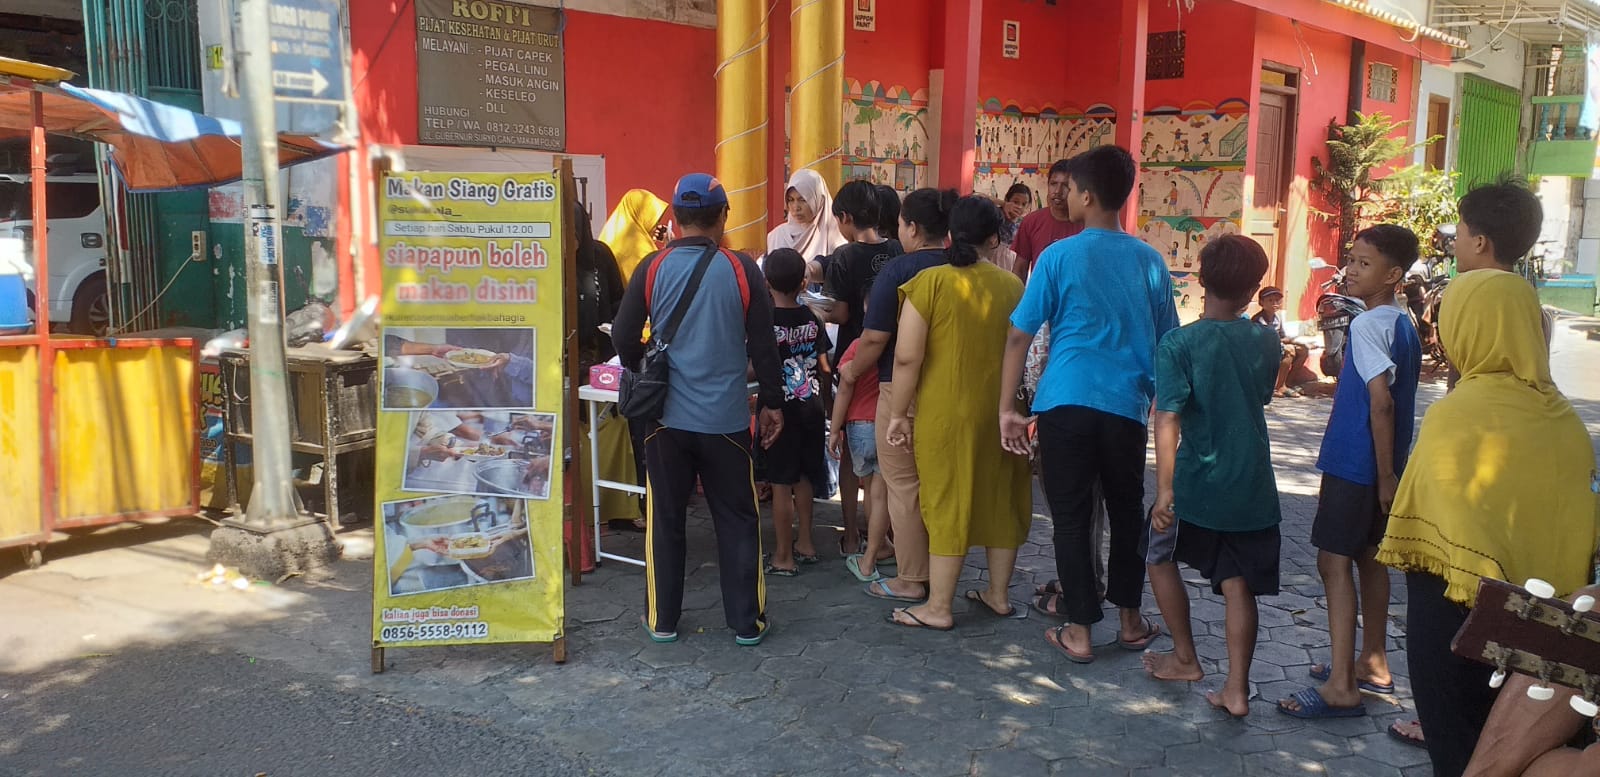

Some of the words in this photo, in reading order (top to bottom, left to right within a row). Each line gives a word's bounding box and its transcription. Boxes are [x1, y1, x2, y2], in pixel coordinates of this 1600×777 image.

[452, 0, 531, 26] ROFI'I
[419, 16, 446, 33] PIJAT
[448, 20, 501, 40] KESEHATAN
[503, 29, 511, 41] &
[512, 30, 536, 45] PIJAT
[537, 33, 559, 48] URUT
[422, 37, 469, 55] MELAYANI
[484, 45, 514, 59] PIJAT
[517, 49, 553, 63] CAPEK
[485, 60, 521, 74] PEGAL
[524, 64, 548, 76] LINU
[485, 74, 524, 88] MASUK
[527, 78, 559, 91] ANGIN
[486, 88, 537, 102] KESELEO
[424, 106, 470, 118] HUBUNGI
[486, 102, 507, 114] DLL
[424, 117, 454, 129] TELP
[486, 121, 510, 133] 0812
[512, 123, 536, 135] 3243
[538, 126, 560, 137] 6688
[387, 177, 443, 198] Makan
[449, 179, 497, 203] Siang
[504, 180, 554, 198] Gratis
[394, 223, 426, 234] Setiap
[447, 224, 476, 234] Sabtu
[478, 225, 504, 234] Pukul
[507, 225, 534, 234] 12.00
[386, 243, 481, 271] siapapun
[489, 243, 545, 266] boleh
[398, 277, 468, 300] makan
[477, 278, 536, 300] disini
[384, 608, 409, 620] kalian
[411, 610, 430, 620] juga
[432, 607, 449, 618] bisa
[450, 606, 477, 617] donasi
[383, 624, 486, 639] 0856-5558-9112
